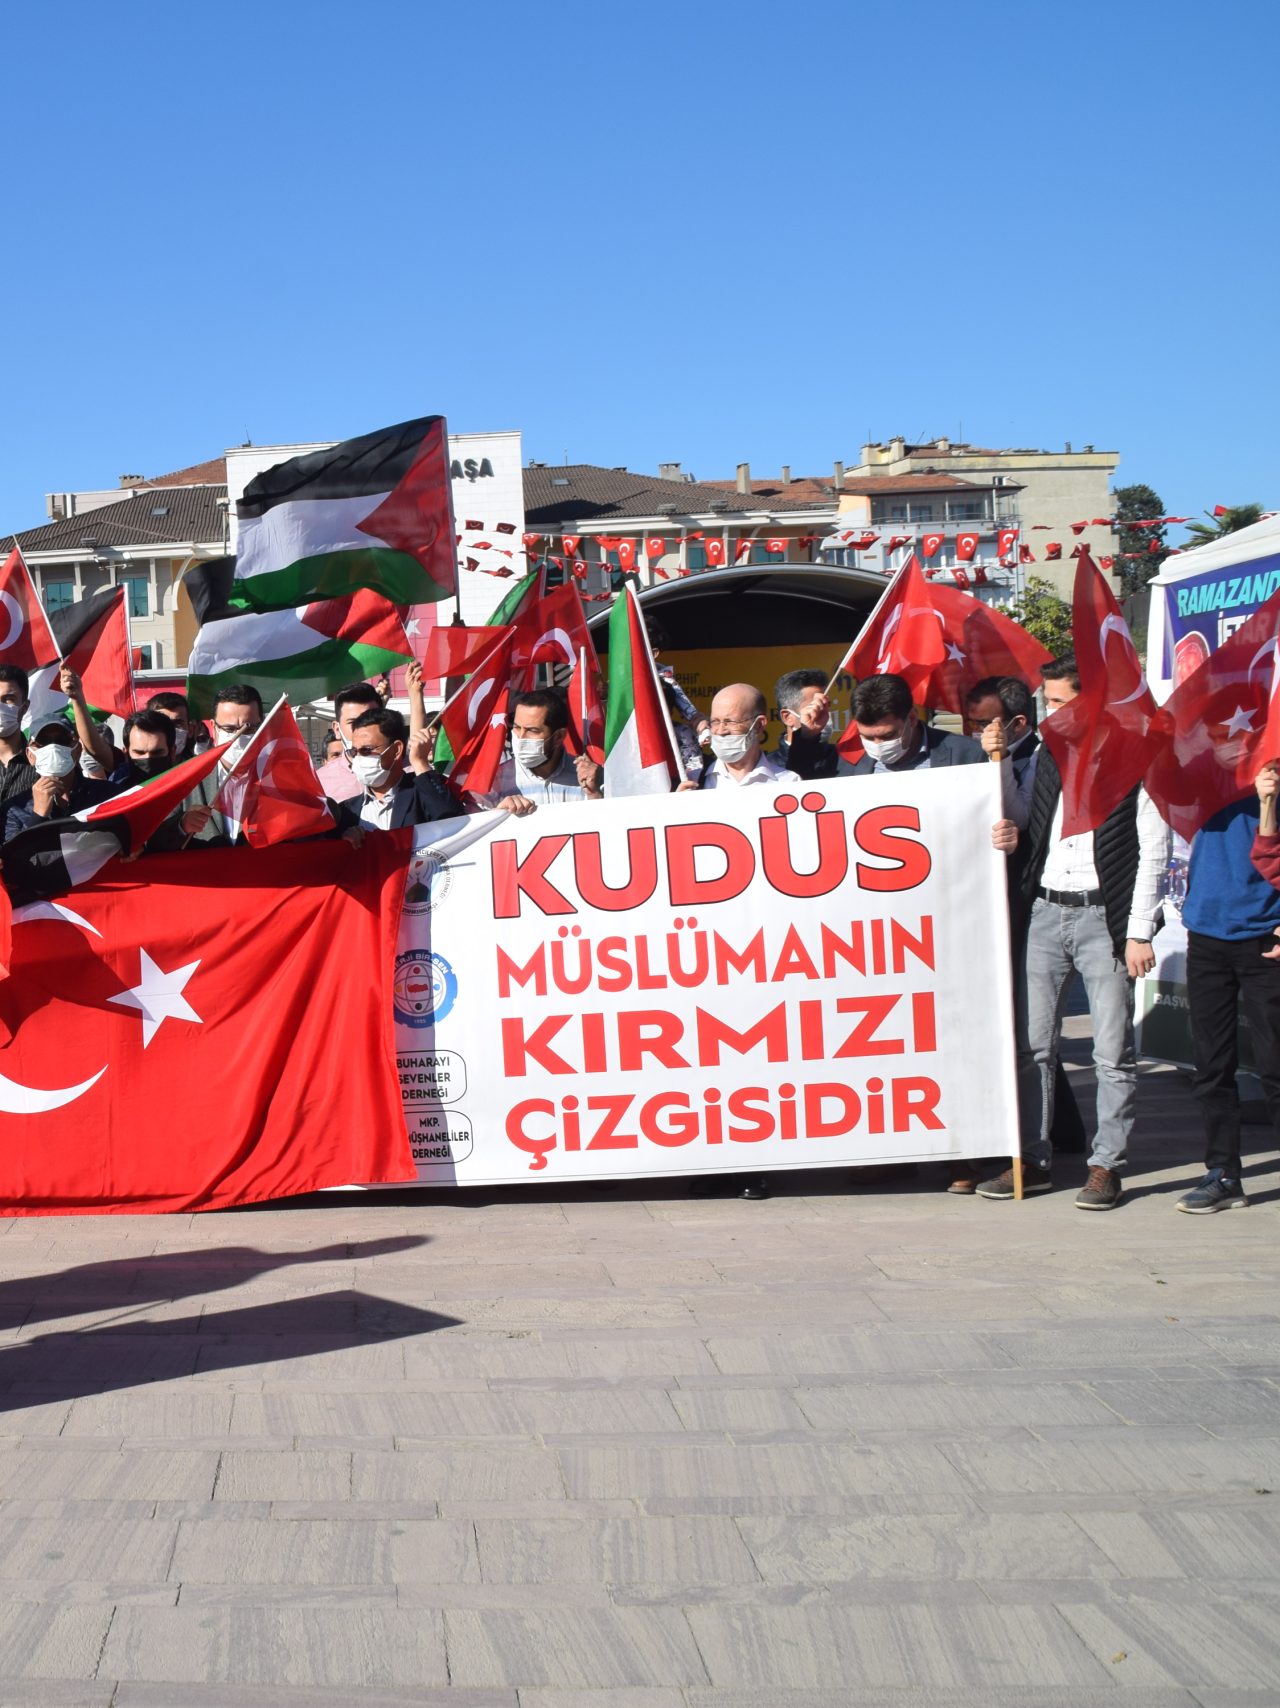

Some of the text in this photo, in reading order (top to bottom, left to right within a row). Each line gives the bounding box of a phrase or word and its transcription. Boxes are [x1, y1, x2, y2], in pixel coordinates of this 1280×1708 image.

[450, 457, 495, 484] AŞA
[491, 792, 932, 919] KUDÜS
[497, 916, 935, 998] MÜSLÜMANIN
[502, 992, 937, 1077] KIRMIZI
[397, 1056, 450, 1069] BUHARAYI
[402, 1086, 448, 1100] DERNEĞİ
[419, 1117, 440, 1128] MKP.
[412, 1145, 451, 1159] DERNEĞİ
